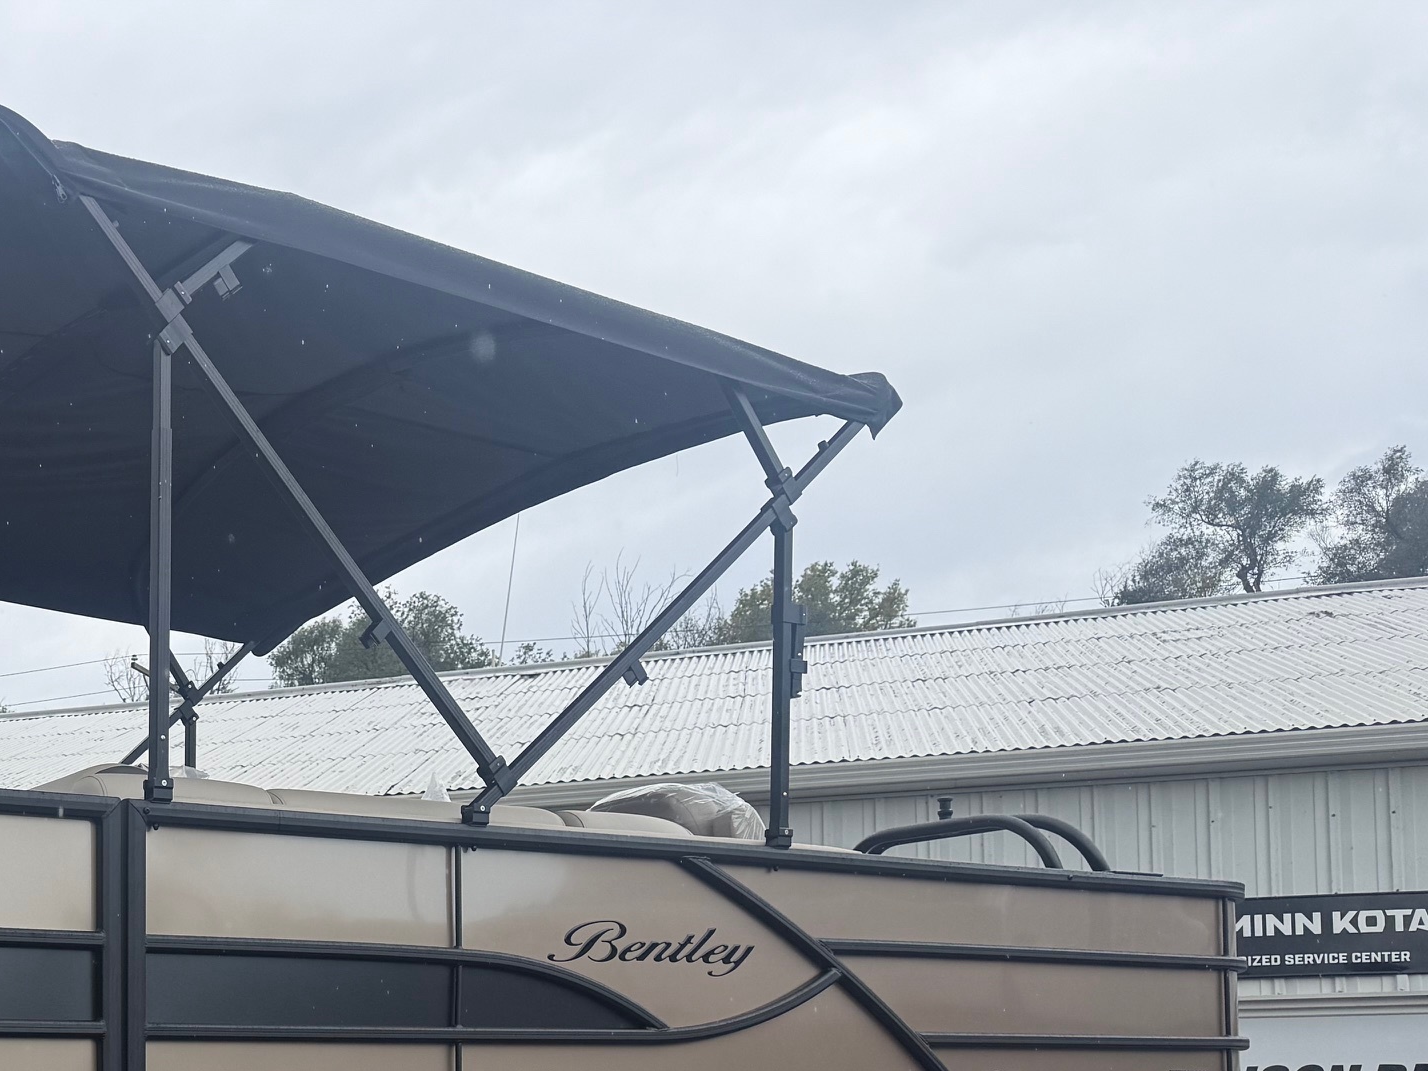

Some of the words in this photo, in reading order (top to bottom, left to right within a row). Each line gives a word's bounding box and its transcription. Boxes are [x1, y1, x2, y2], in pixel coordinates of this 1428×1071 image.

[1332, 908, 1428, 935] KOTA
[546, 919, 756, 977] Bentley
[1247, 954, 1281, 967] IZED
[1284, 952, 1348, 966] SERVICE
[1351, 950, 1411, 964] CENTER
